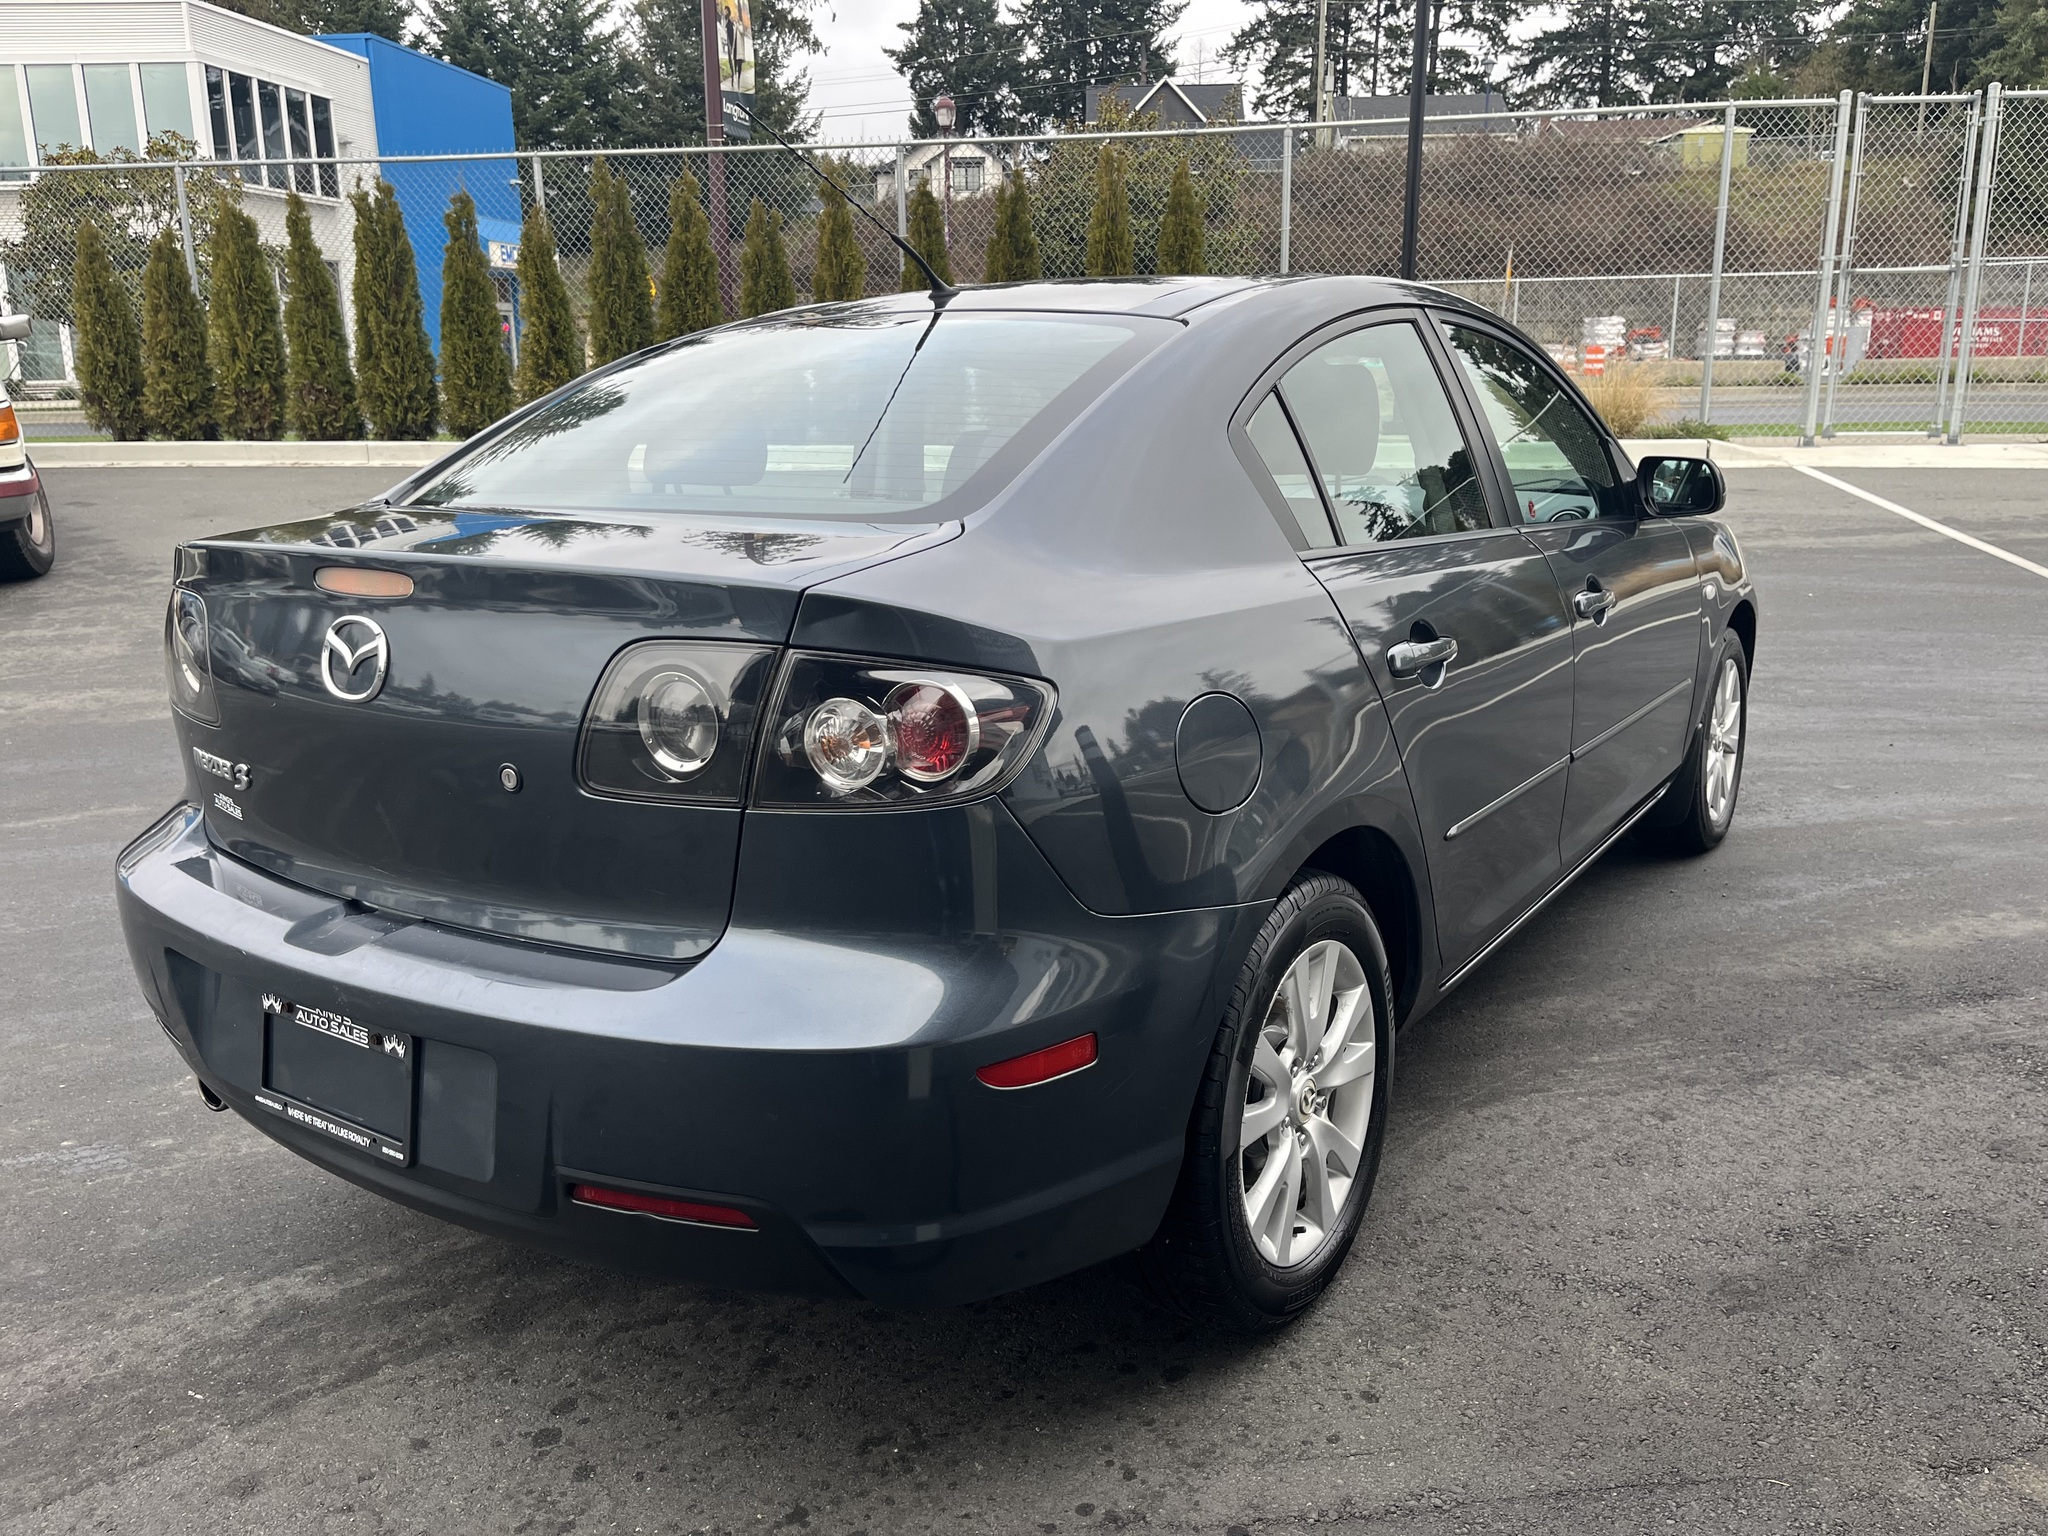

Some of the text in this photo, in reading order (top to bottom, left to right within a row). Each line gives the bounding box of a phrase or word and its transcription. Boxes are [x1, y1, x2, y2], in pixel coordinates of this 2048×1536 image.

[296, 1009, 369, 1044] AUTO SALES
[287, 1106, 370, 1148] WHERE WE TREAT YOU LIKE ROYALTY
